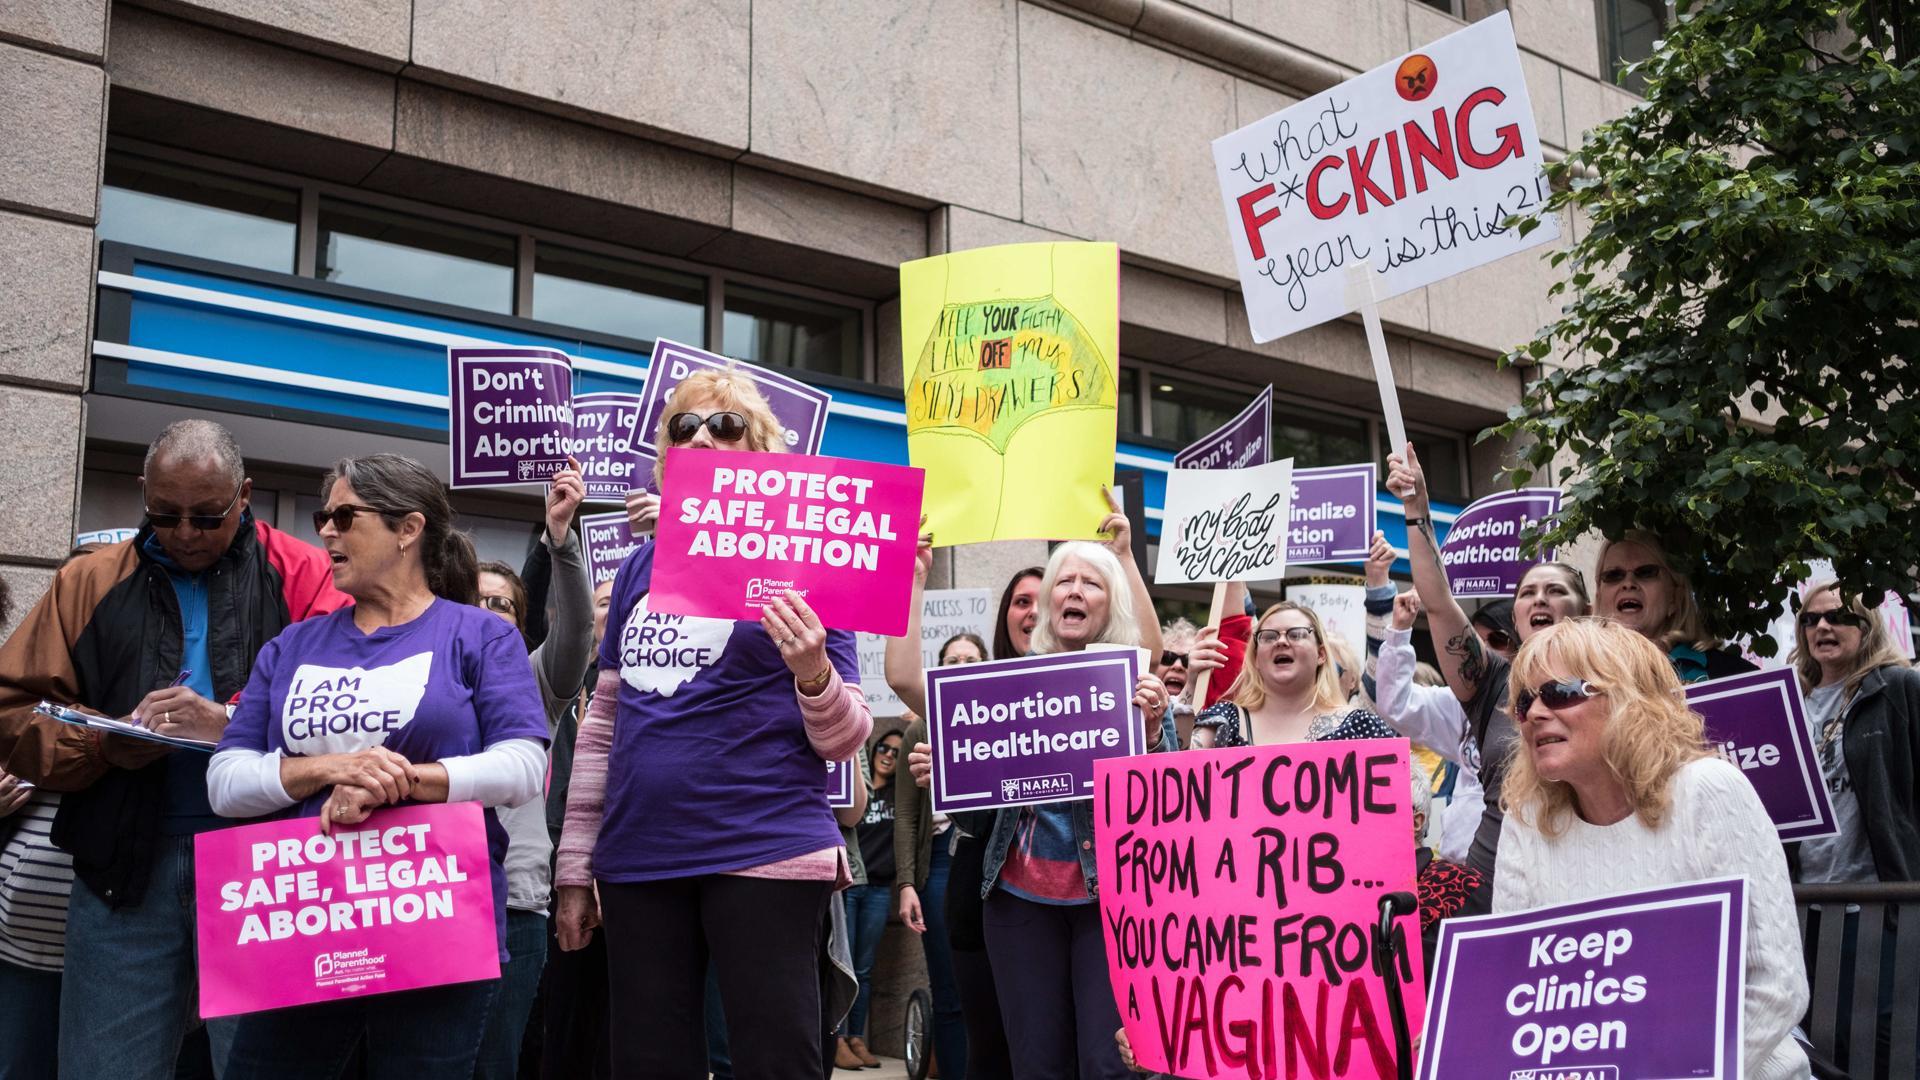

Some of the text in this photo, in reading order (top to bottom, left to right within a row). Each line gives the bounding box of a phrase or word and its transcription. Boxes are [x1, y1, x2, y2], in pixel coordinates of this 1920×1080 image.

[1377, 237, 1425, 274] is
[983, 305, 1019, 335] YOUR
[1020, 306, 1065, 337] FILTHY
[932, 335, 977, 373] LAWS
[981, 341, 1009, 369] OFF
[472, 368, 544, 391] Don't
[576, 413, 610, 432] my
[573, 433, 628, 453] ortio
[1187, 440, 1233, 469] Don't
[537, 463, 571, 474] NARA
[581, 456, 635, 477] vider
[589, 484, 625, 493] NARAL
[712, 467, 873, 504] PROTECT
[679, 498, 897, 541] SAFE, LEGAL
[1290, 501, 1356, 522] inalize
[590, 526, 619, 543] Don't
[687, 531, 880, 571] ABORTION
[1289, 547, 1321, 556] NARAL
[764, 578, 794, 587] Planned
[1466, 580, 1496, 588] NARAL
[630, 608, 685, 625] I AM
[923, 597, 987, 617] ACCESS TO
[624, 626, 689, 646] PRO-
[920, 624, 982, 640] BORTIONS
[622, 648, 712, 668] CHOICE
[294, 675, 361, 695] I AM
[289, 693, 369, 716] PRO-
[950, 685, 1116, 727] Abortion is
[288, 710, 401, 740] CHOICE
[952, 727, 1120, 764] Healthcare
[1023, 777, 1068, 792] NARAL
[1104, 750, 1398, 828] I DIDN'T COME
[251, 823, 431, 872] PROTECT
[1115, 830, 1199, 907] FROM
[1215, 838, 1236, 883] A
[220, 855, 467, 912] SAFE, LEGAL
[237, 889, 454, 945] ABORTION
[333, 948, 368, 960] Planned
[1106, 905, 1414, 986] YOU CAME FROM
[1528, 928, 1633, 968] Keep
[334, 955, 385, 969] Parenthood
[1505, 969, 1647, 1016] Clinics
[1128, 975, 1400, 1080] A VAGINA
[1511, 1019, 1627, 1065] Open
